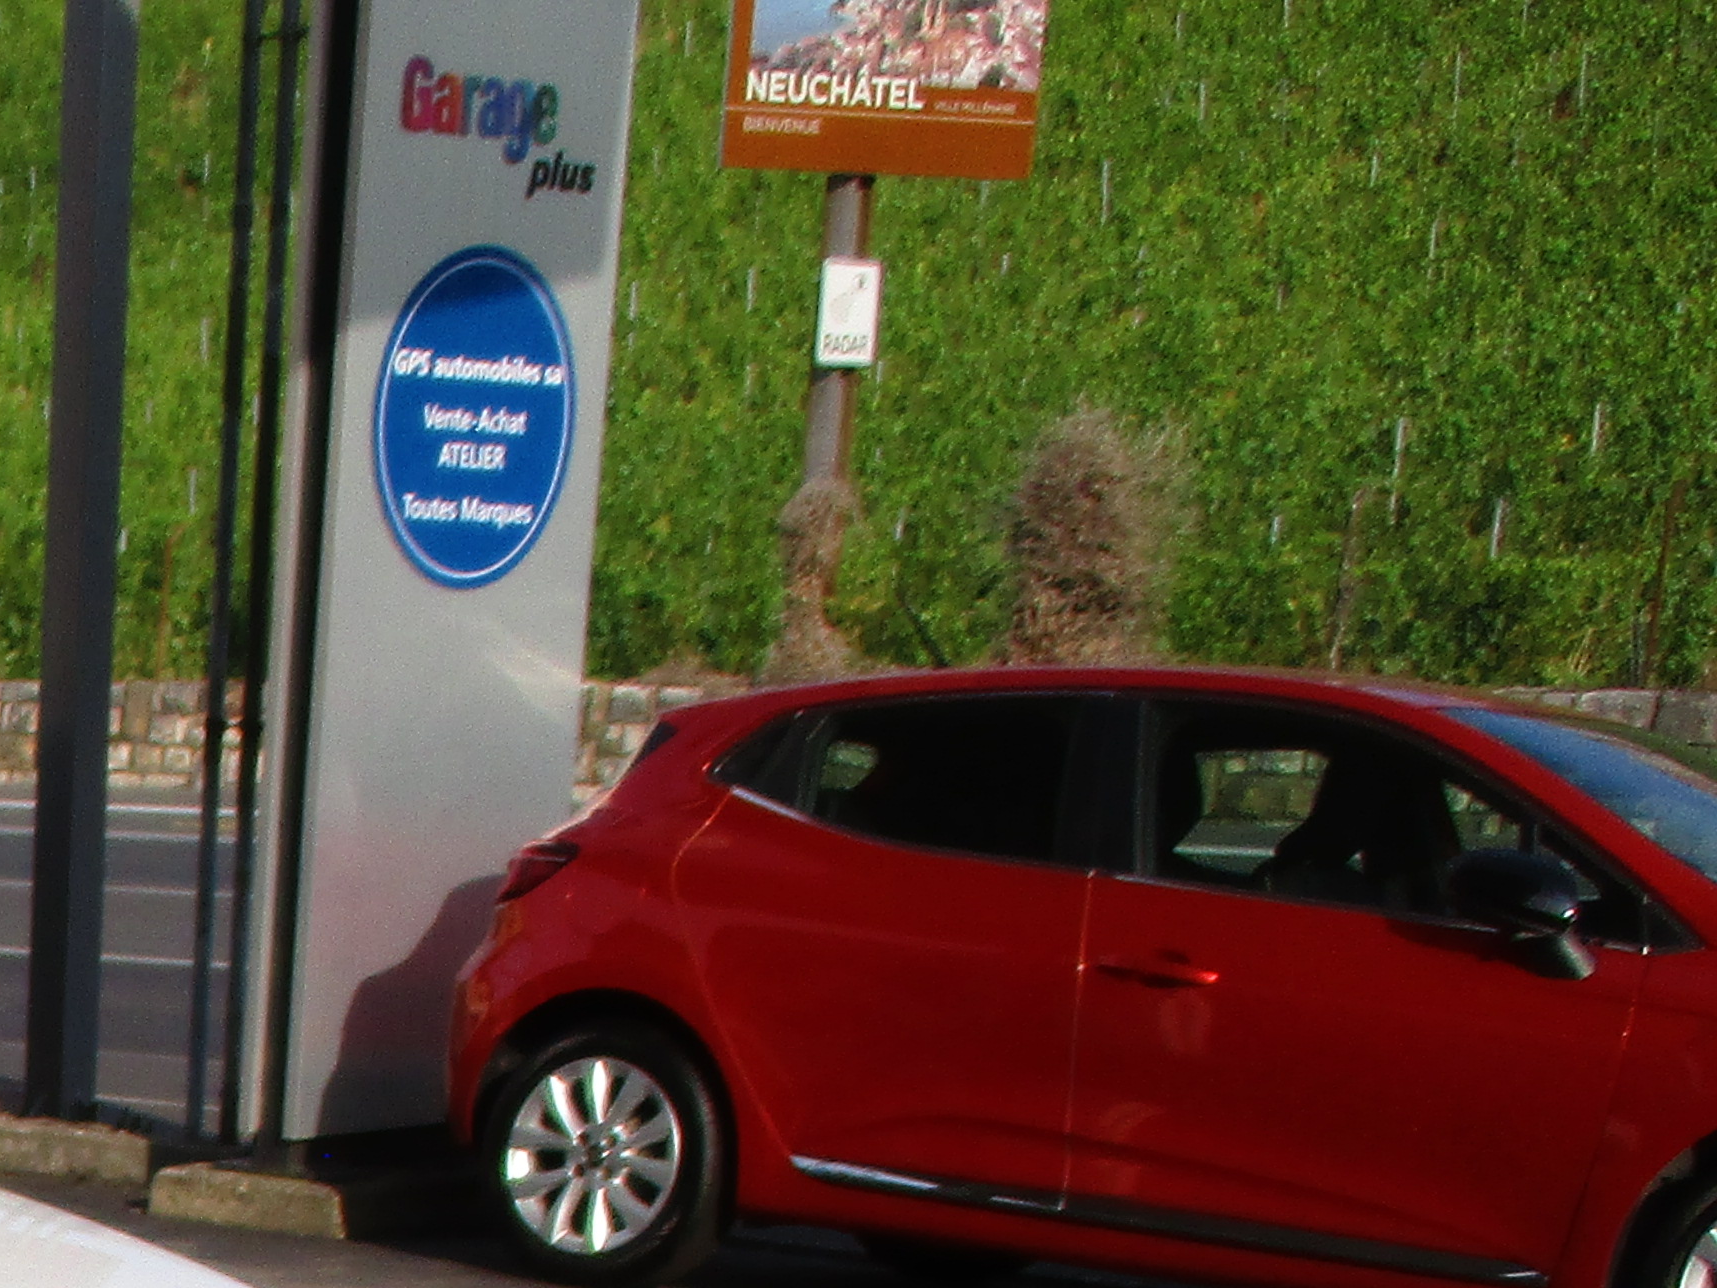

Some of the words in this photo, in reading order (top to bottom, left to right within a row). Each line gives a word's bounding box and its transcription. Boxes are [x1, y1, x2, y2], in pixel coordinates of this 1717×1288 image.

[745, 68, 925, 111] NEUCHÂTEL
[401, 55, 559, 164] Garage
[525, 150, 596, 198] plus
[394, 349, 432, 377] GPS
[433, 355, 542, 384] automobiles
[543, 365, 565, 385] sa
[424, 403, 528, 435] Vente-Achat
[437, 441, 508, 470] ATELIER
[402, 493, 458, 520] Toutes
[460, 497, 533, 529] Marques
